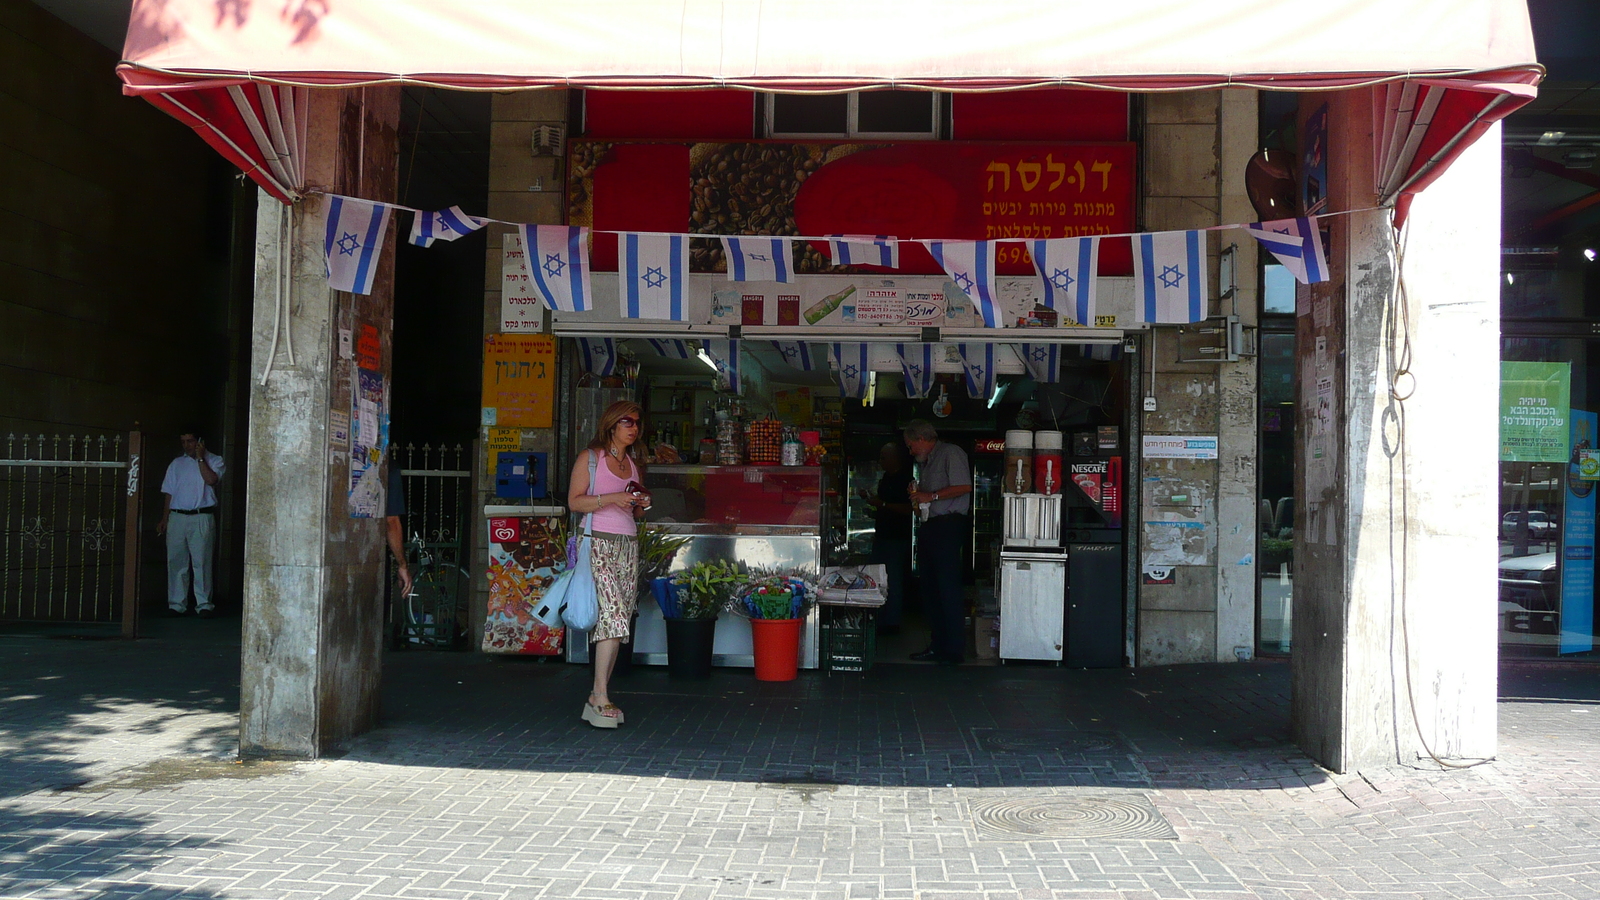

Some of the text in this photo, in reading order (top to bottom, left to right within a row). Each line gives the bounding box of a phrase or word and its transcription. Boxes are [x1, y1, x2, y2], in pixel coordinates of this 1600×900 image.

[982, 202, 1115, 216] מתנות פירות יבשים
[508, 296, 537, 305] טלכארט
[504, 320, 539, 329] שרותי פקס
[1518, 397, 1547, 406] מי יהיה
[1510, 406, 1556, 415] הכוכב הבא
[1550, 416, 1564, 426] של
